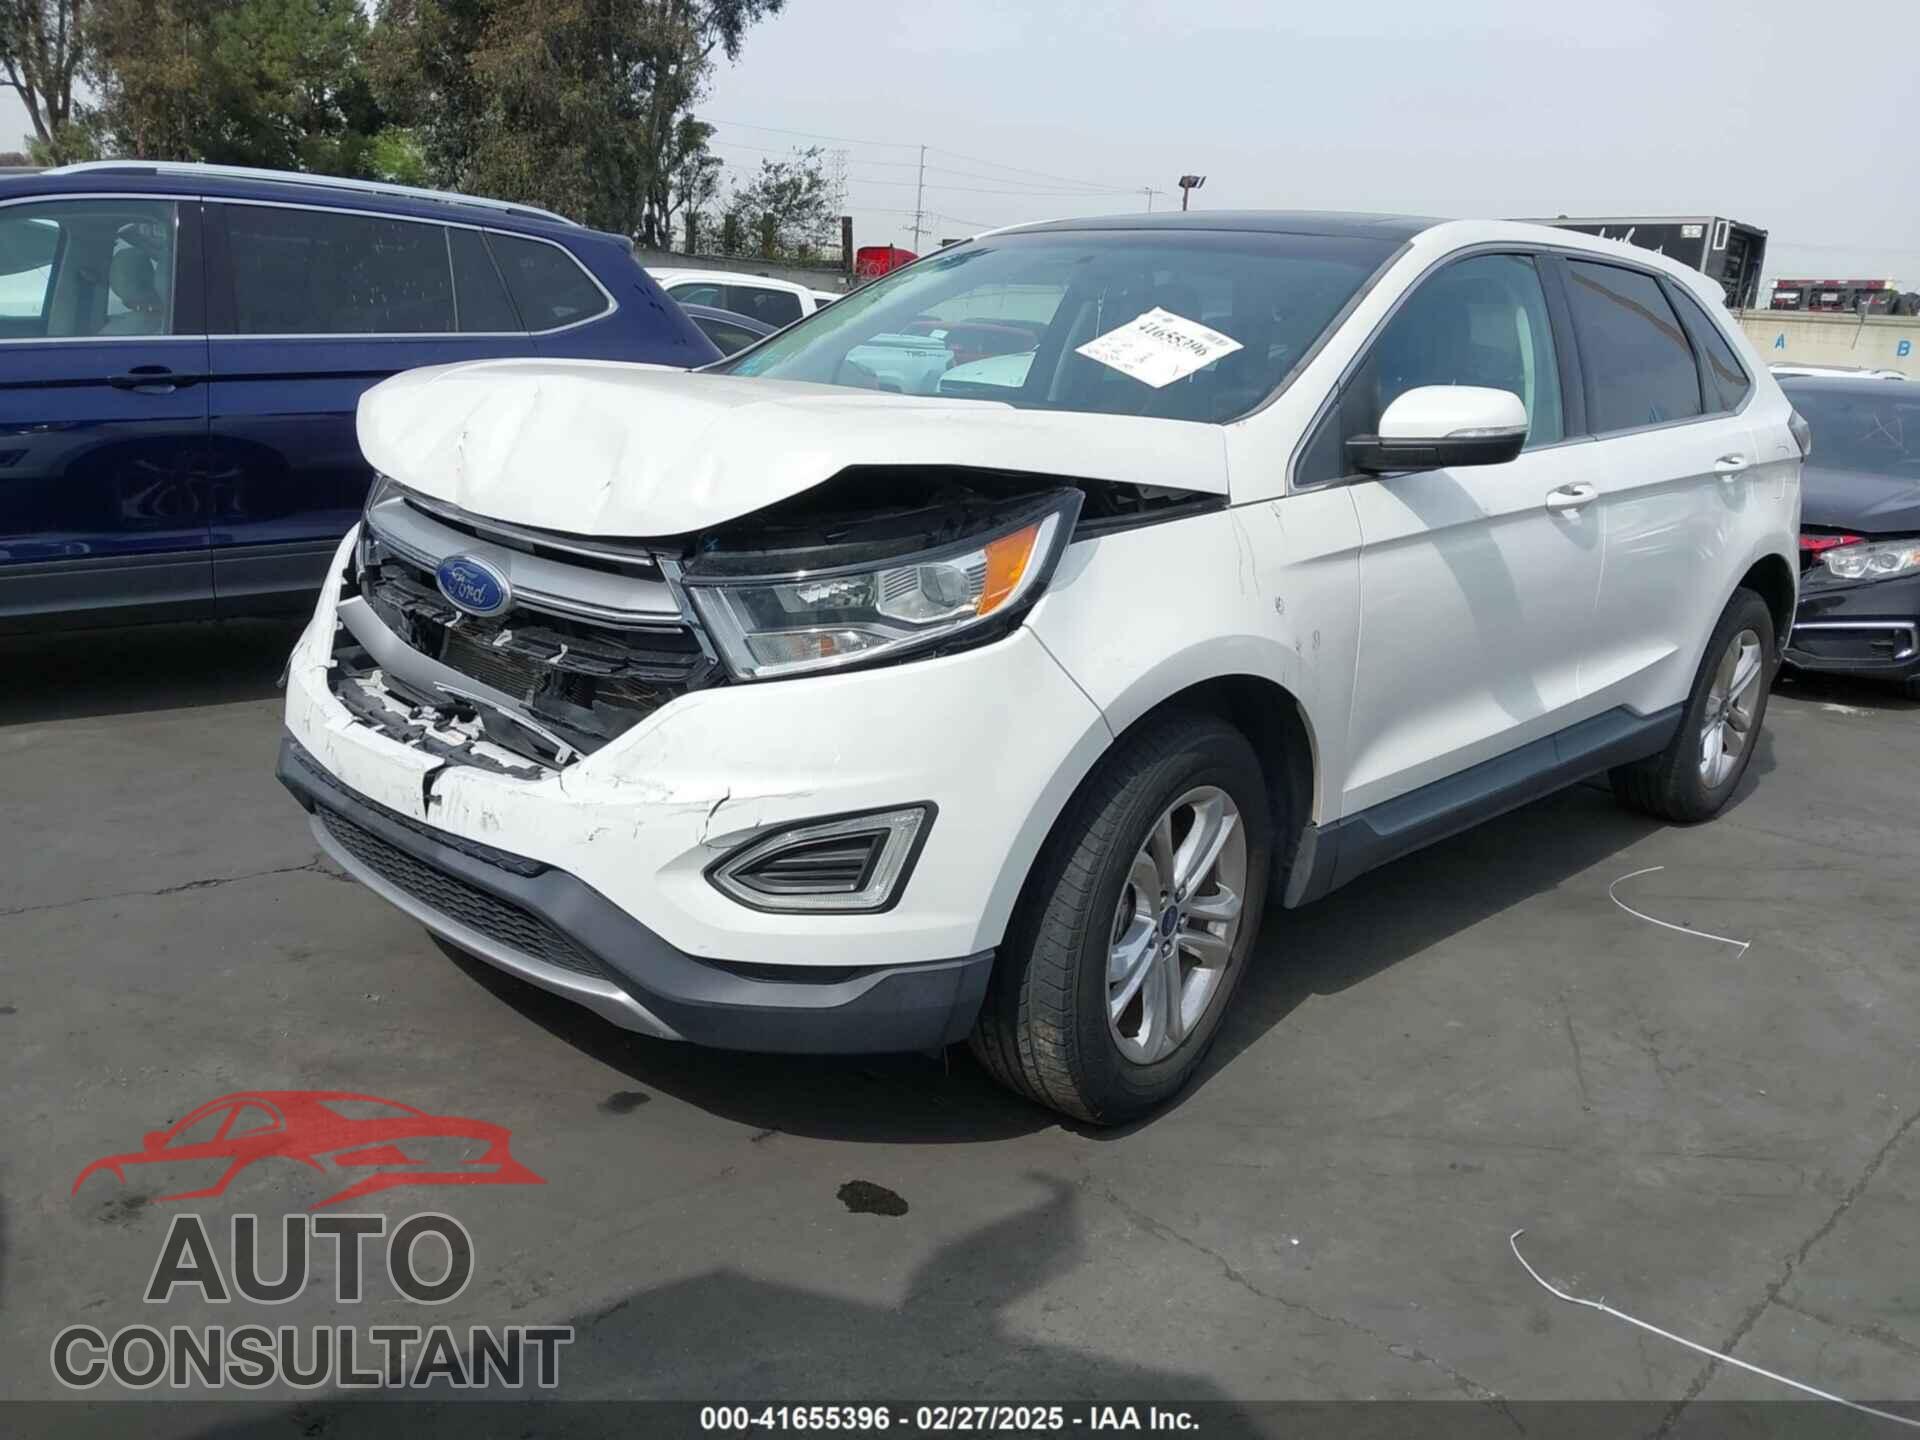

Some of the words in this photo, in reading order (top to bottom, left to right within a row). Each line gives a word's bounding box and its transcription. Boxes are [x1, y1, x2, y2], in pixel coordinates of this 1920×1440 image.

[1775, 333, 1786, 349] A
[1896, 340, 1911, 356] B
[447, 566, 489, 604] Ford
